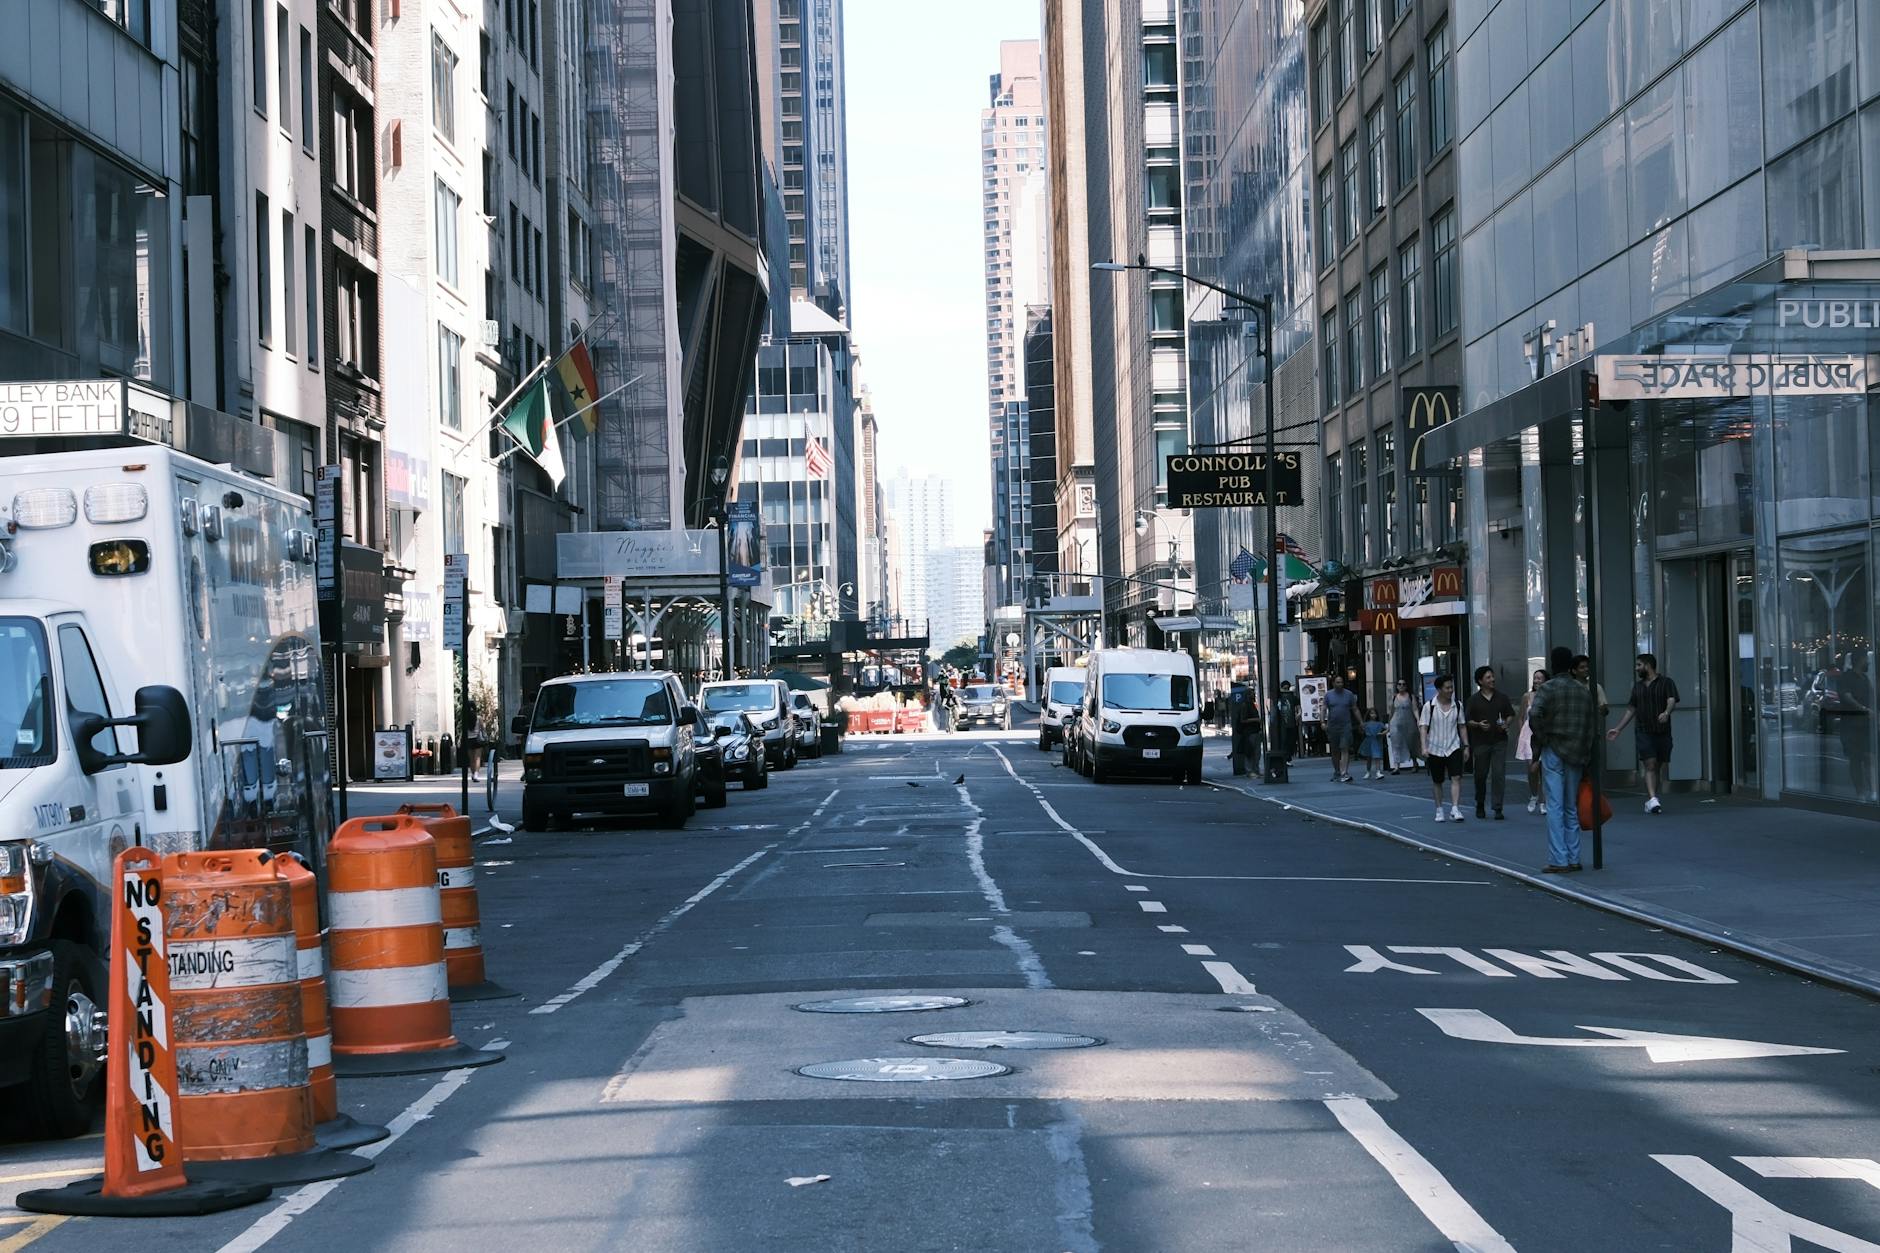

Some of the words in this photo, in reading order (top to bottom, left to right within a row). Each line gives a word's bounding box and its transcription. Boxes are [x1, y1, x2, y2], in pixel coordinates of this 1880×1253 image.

[0, 385, 47, 403] LEY
[56, 384, 116, 402] BANK
[31, 404, 118, 432] FIFTH
[1171, 453, 1297, 472] CONNOLL'S
[1219, 476, 1251, 488] PUB
[1182, 491, 1287, 506] RESTAURAT
[126, 878, 161, 909] NO
[168, 950, 234, 975] STANDING
[1344, 944, 1739, 984] ONLY
[137, 917, 164, 1163] STANDING
